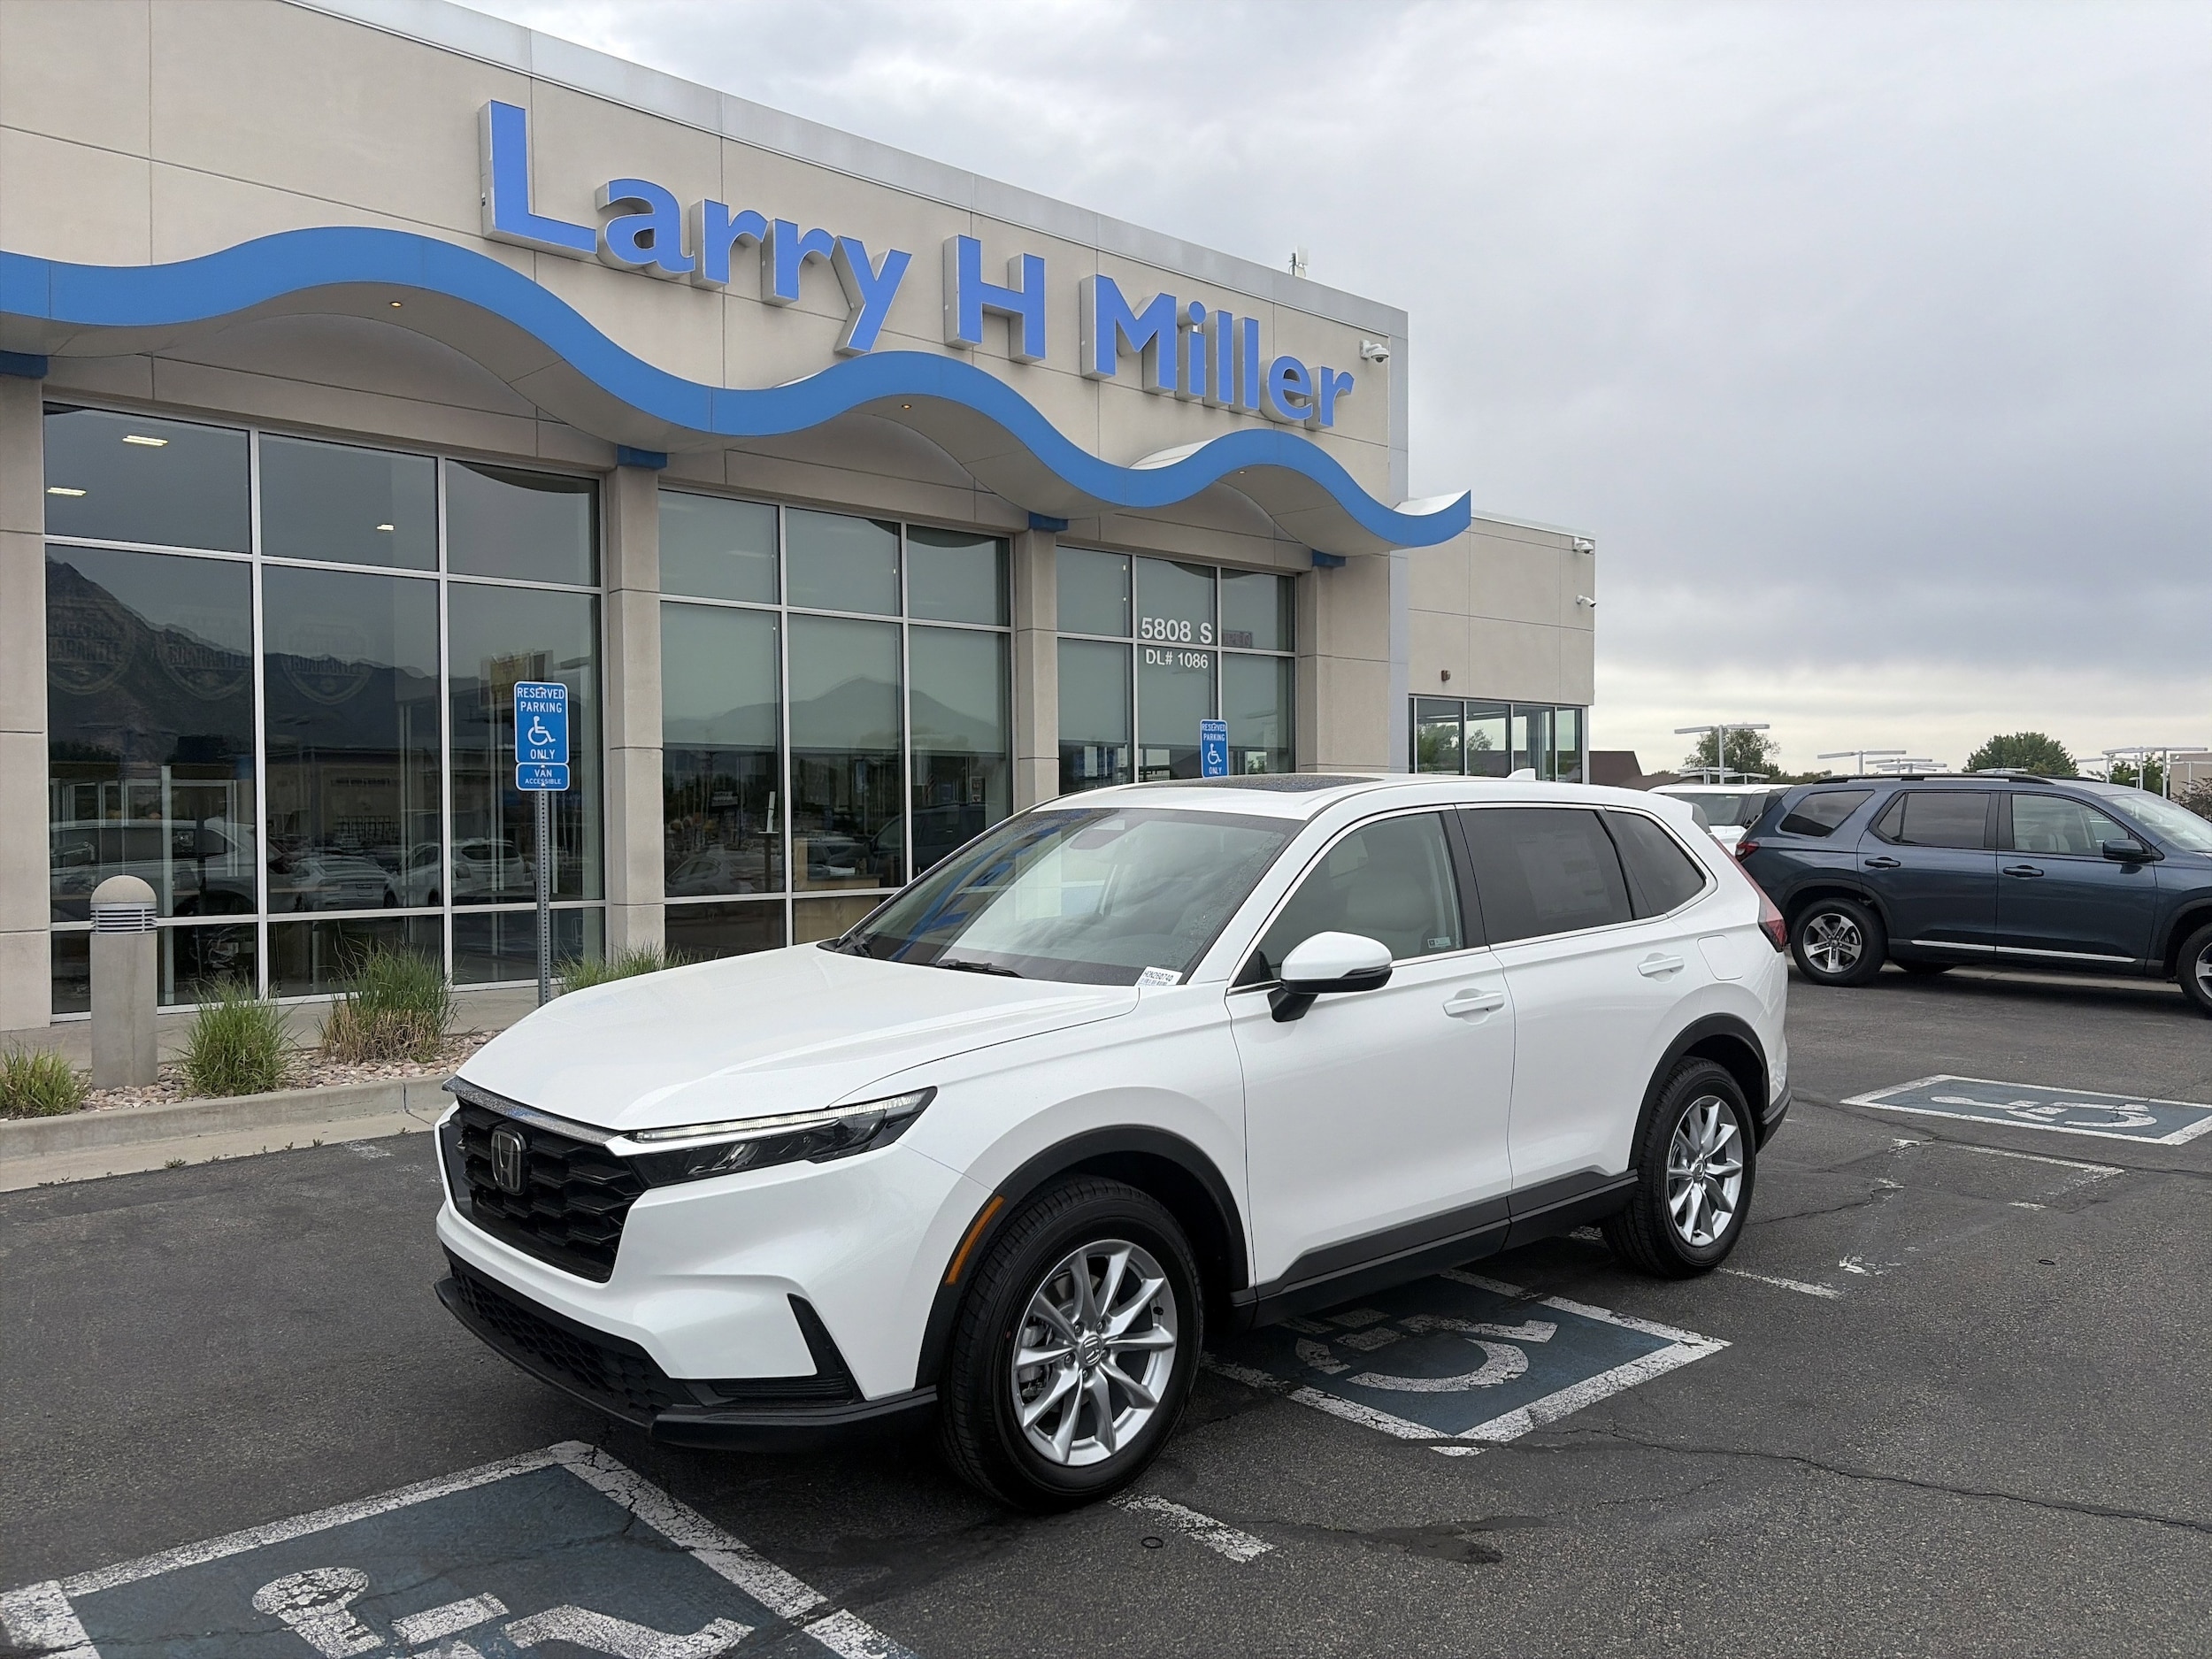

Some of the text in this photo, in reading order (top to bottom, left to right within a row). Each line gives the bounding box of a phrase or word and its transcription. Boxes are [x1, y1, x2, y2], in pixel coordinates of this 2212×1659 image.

[479, 99, 1355, 430] Larry H Miller
[1141, 617, 1212, 644] 5808 S
[1145, 649, 1209, 669] DL# 1086
[517, 687, 565, 699] RESERVED
[520, 701, 563, 713] PARKING
[1202, 723, 1226, 732] RESERVED
[1203, 733, 1225, 742] PARKING
[530, 749, 556, 760] ONLY
[1209, 766, 1223, 775] ONLY
